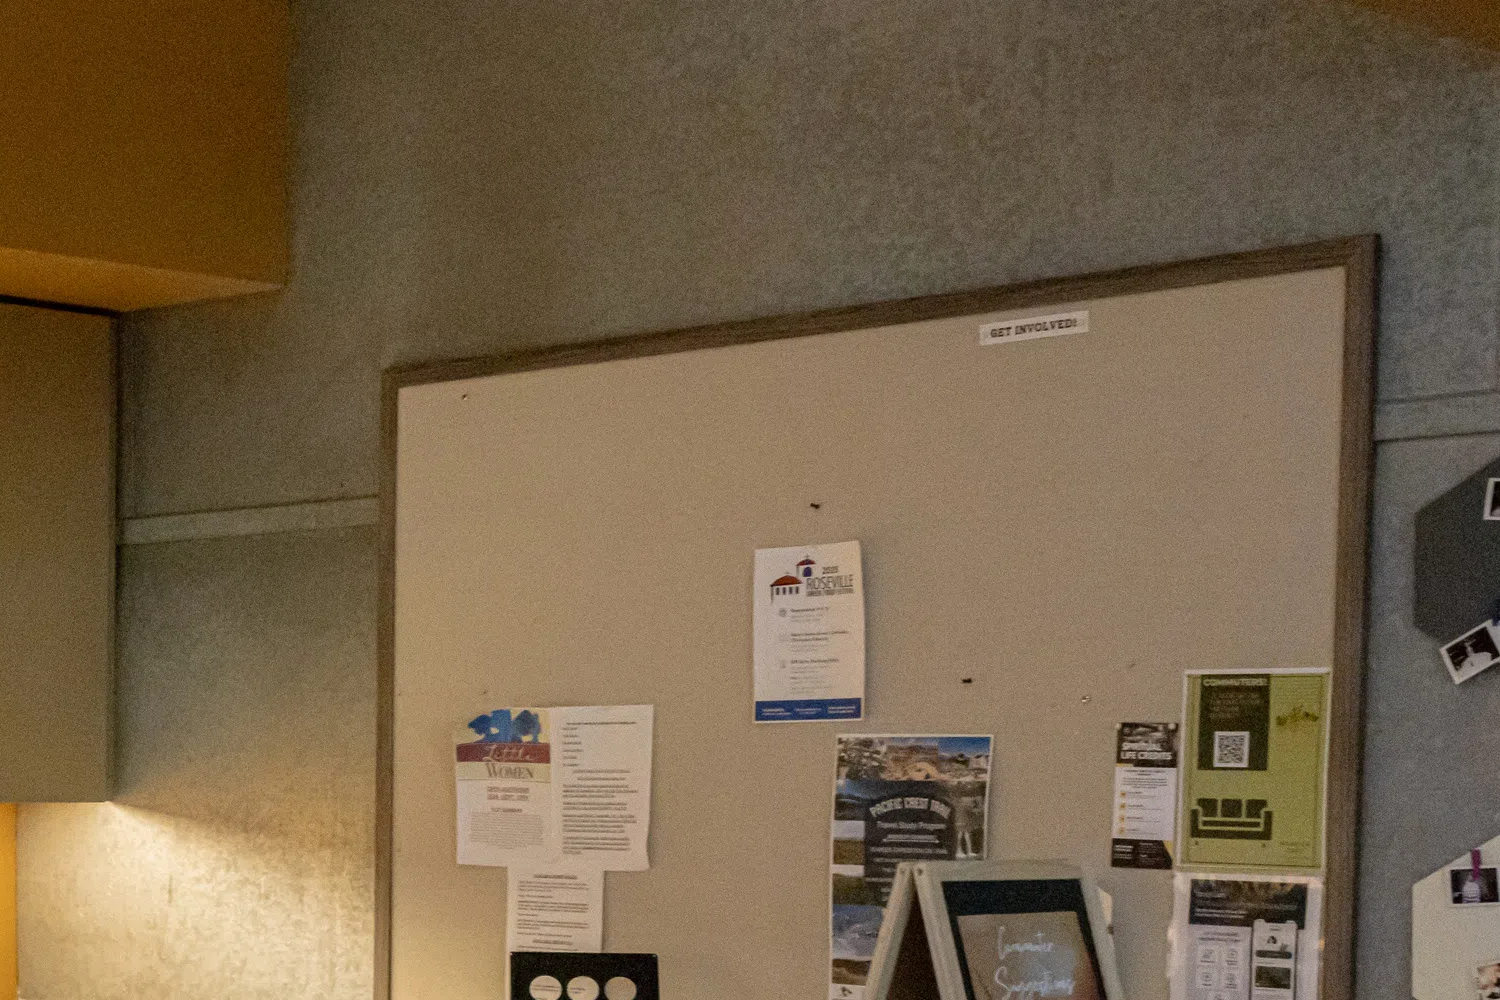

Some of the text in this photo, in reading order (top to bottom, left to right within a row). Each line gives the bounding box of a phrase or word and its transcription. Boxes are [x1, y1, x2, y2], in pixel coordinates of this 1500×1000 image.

[990, 326, 1013, 338] GET
[806, 574, 854, 590] ROSEVILLE
[1120, 751, 1136, 760] LIFE
